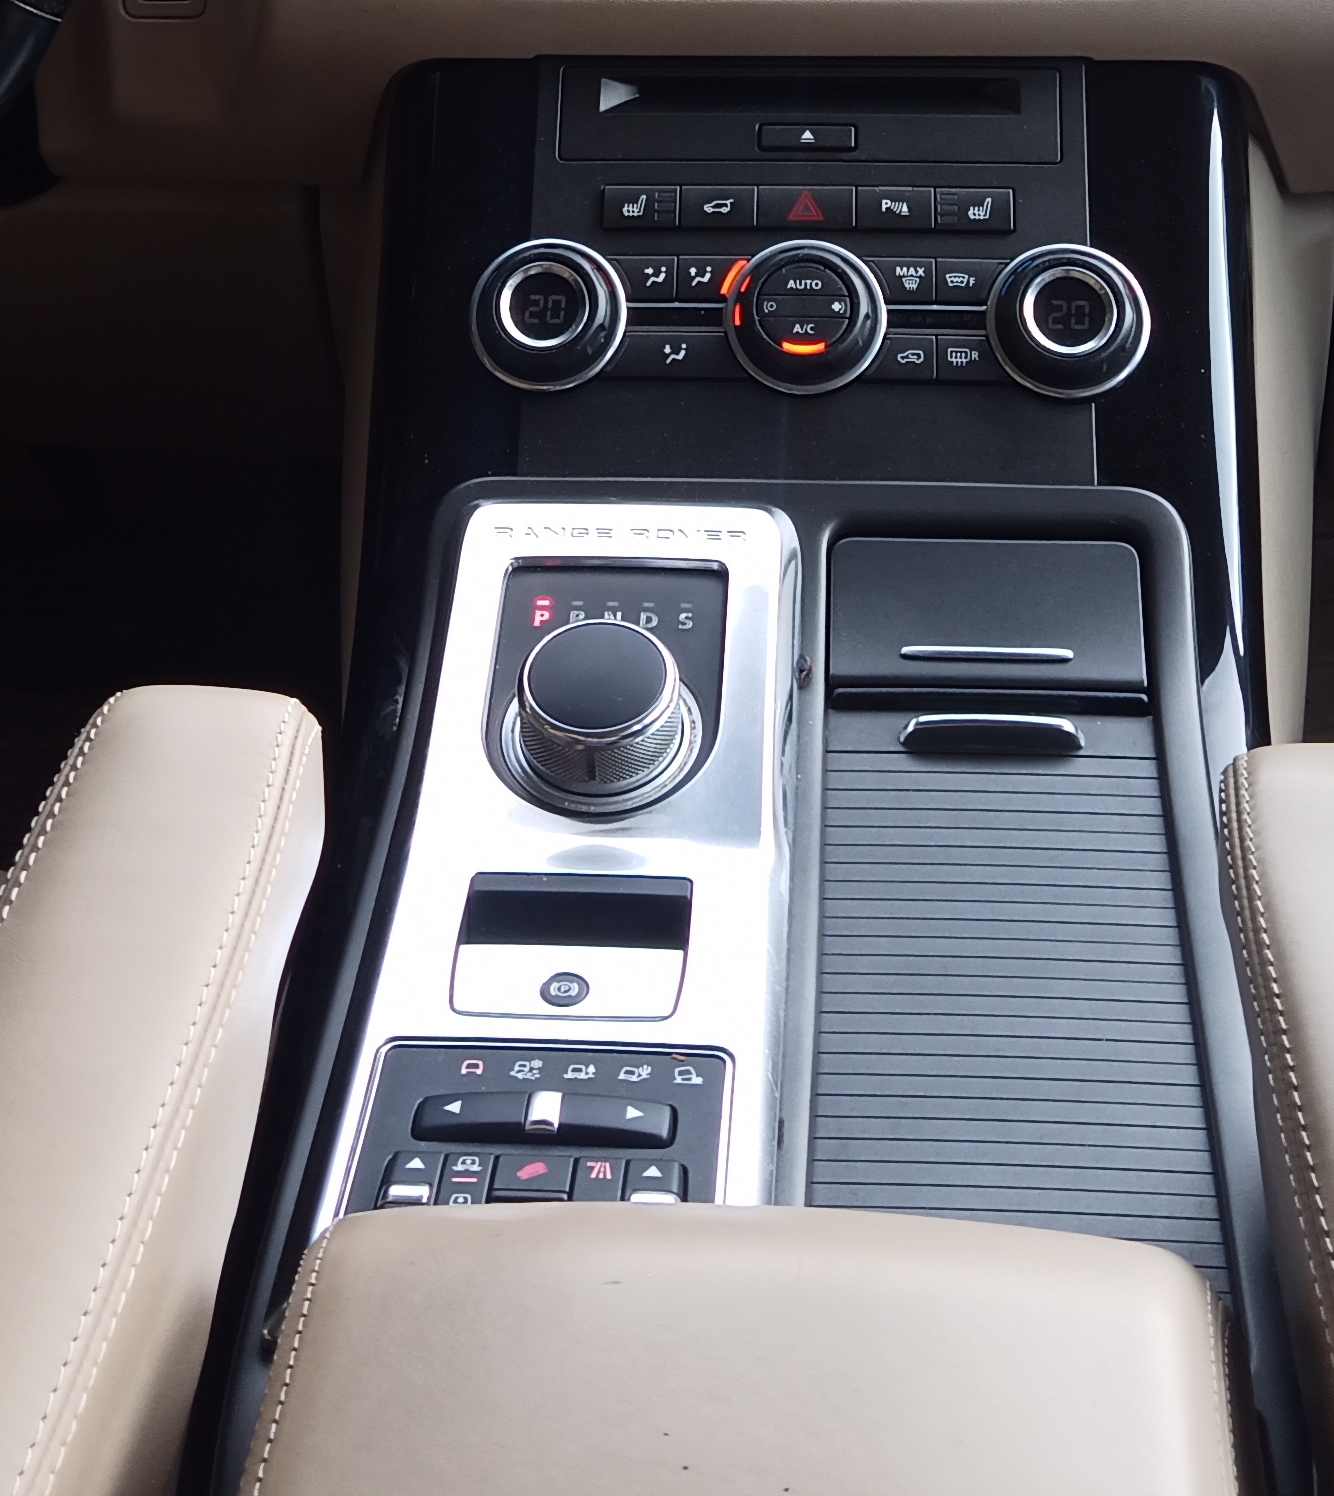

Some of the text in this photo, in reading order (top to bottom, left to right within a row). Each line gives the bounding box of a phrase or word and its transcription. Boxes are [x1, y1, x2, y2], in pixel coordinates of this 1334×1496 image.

[896, 267, 925, 277] MAX
[787, 280, 822, 290] AUTO
[524, 294, 566, 323] 20
[1048, 300, 1090, 329] 20
[793, 324, 816, 334] A/C
[494, 526, 748, 543] RANGE ROVER
[533, 610, 550, 627] P
[639, 611, 659, 628] D
[678, 612, 694, 630] S
